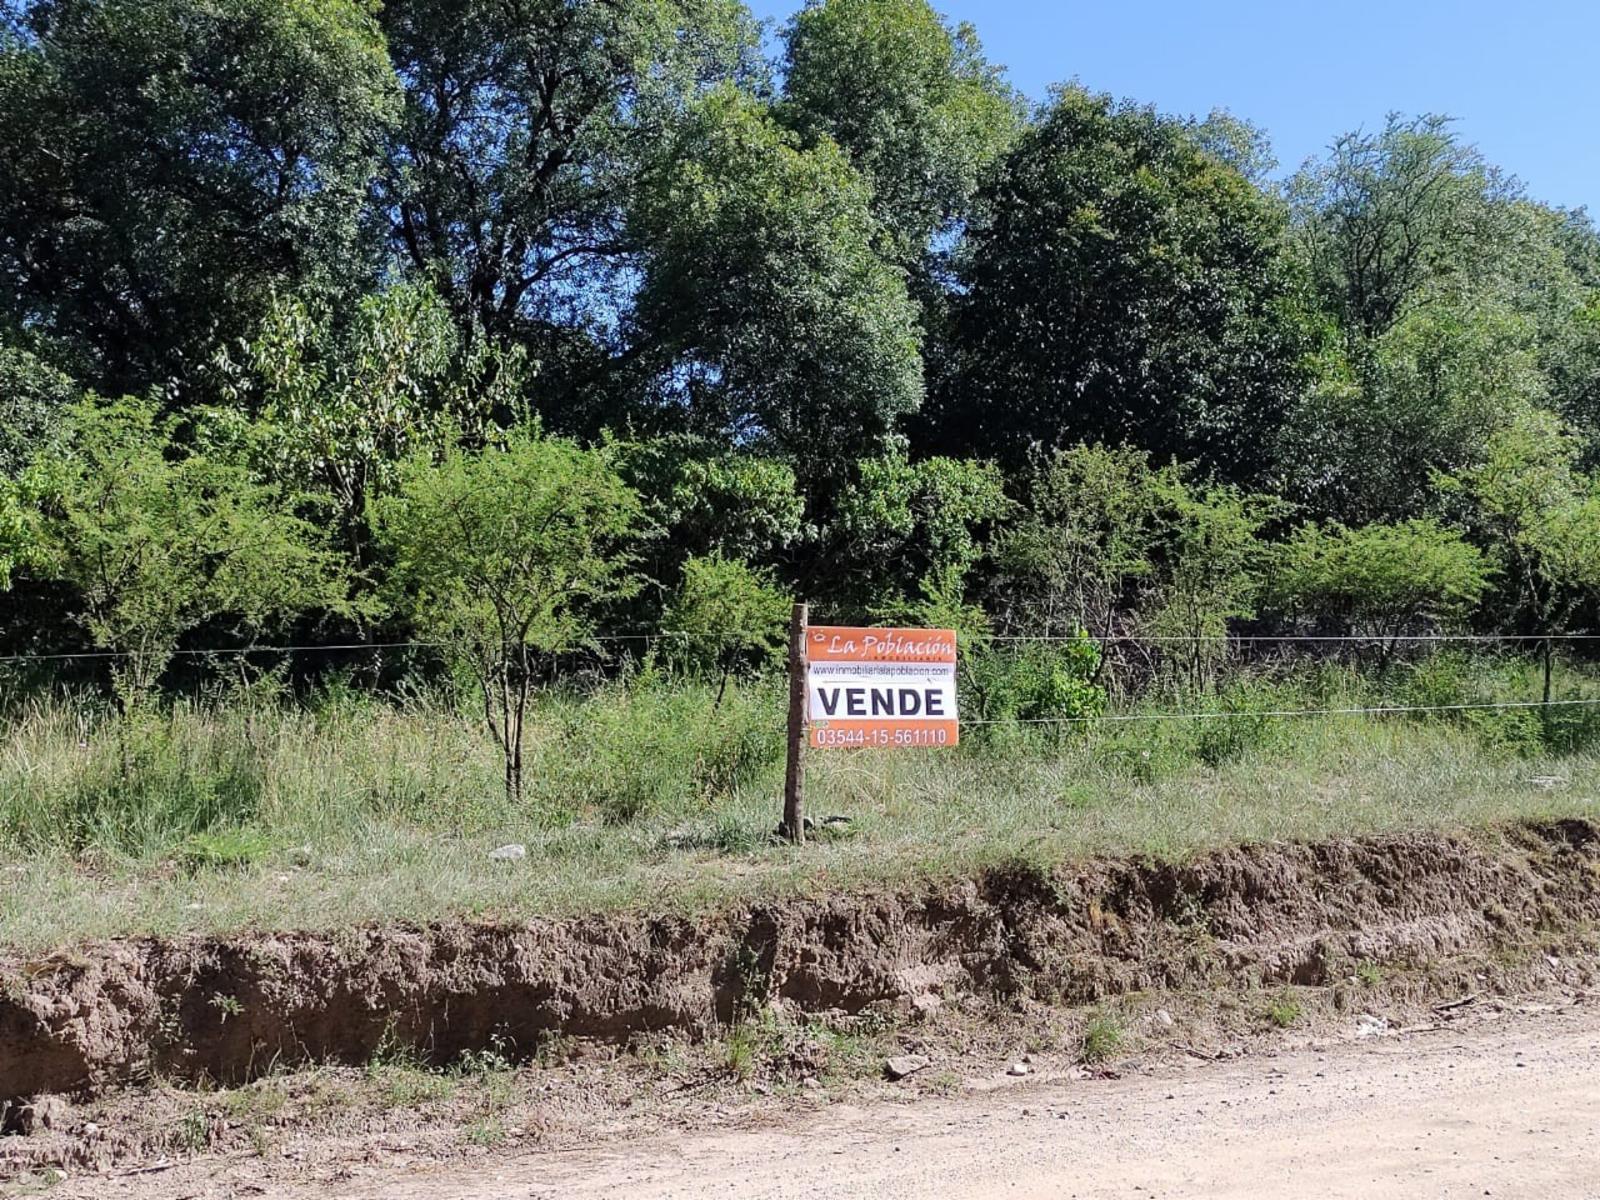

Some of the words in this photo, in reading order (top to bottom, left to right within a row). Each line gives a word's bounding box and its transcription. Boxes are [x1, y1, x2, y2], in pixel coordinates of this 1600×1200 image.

[827, 635, 857, 654] La
[861, 632, 954, 657] Población
[817, 688, 945, 716] VENDE
[817, 729, 947, 745] 03544-15-561110
